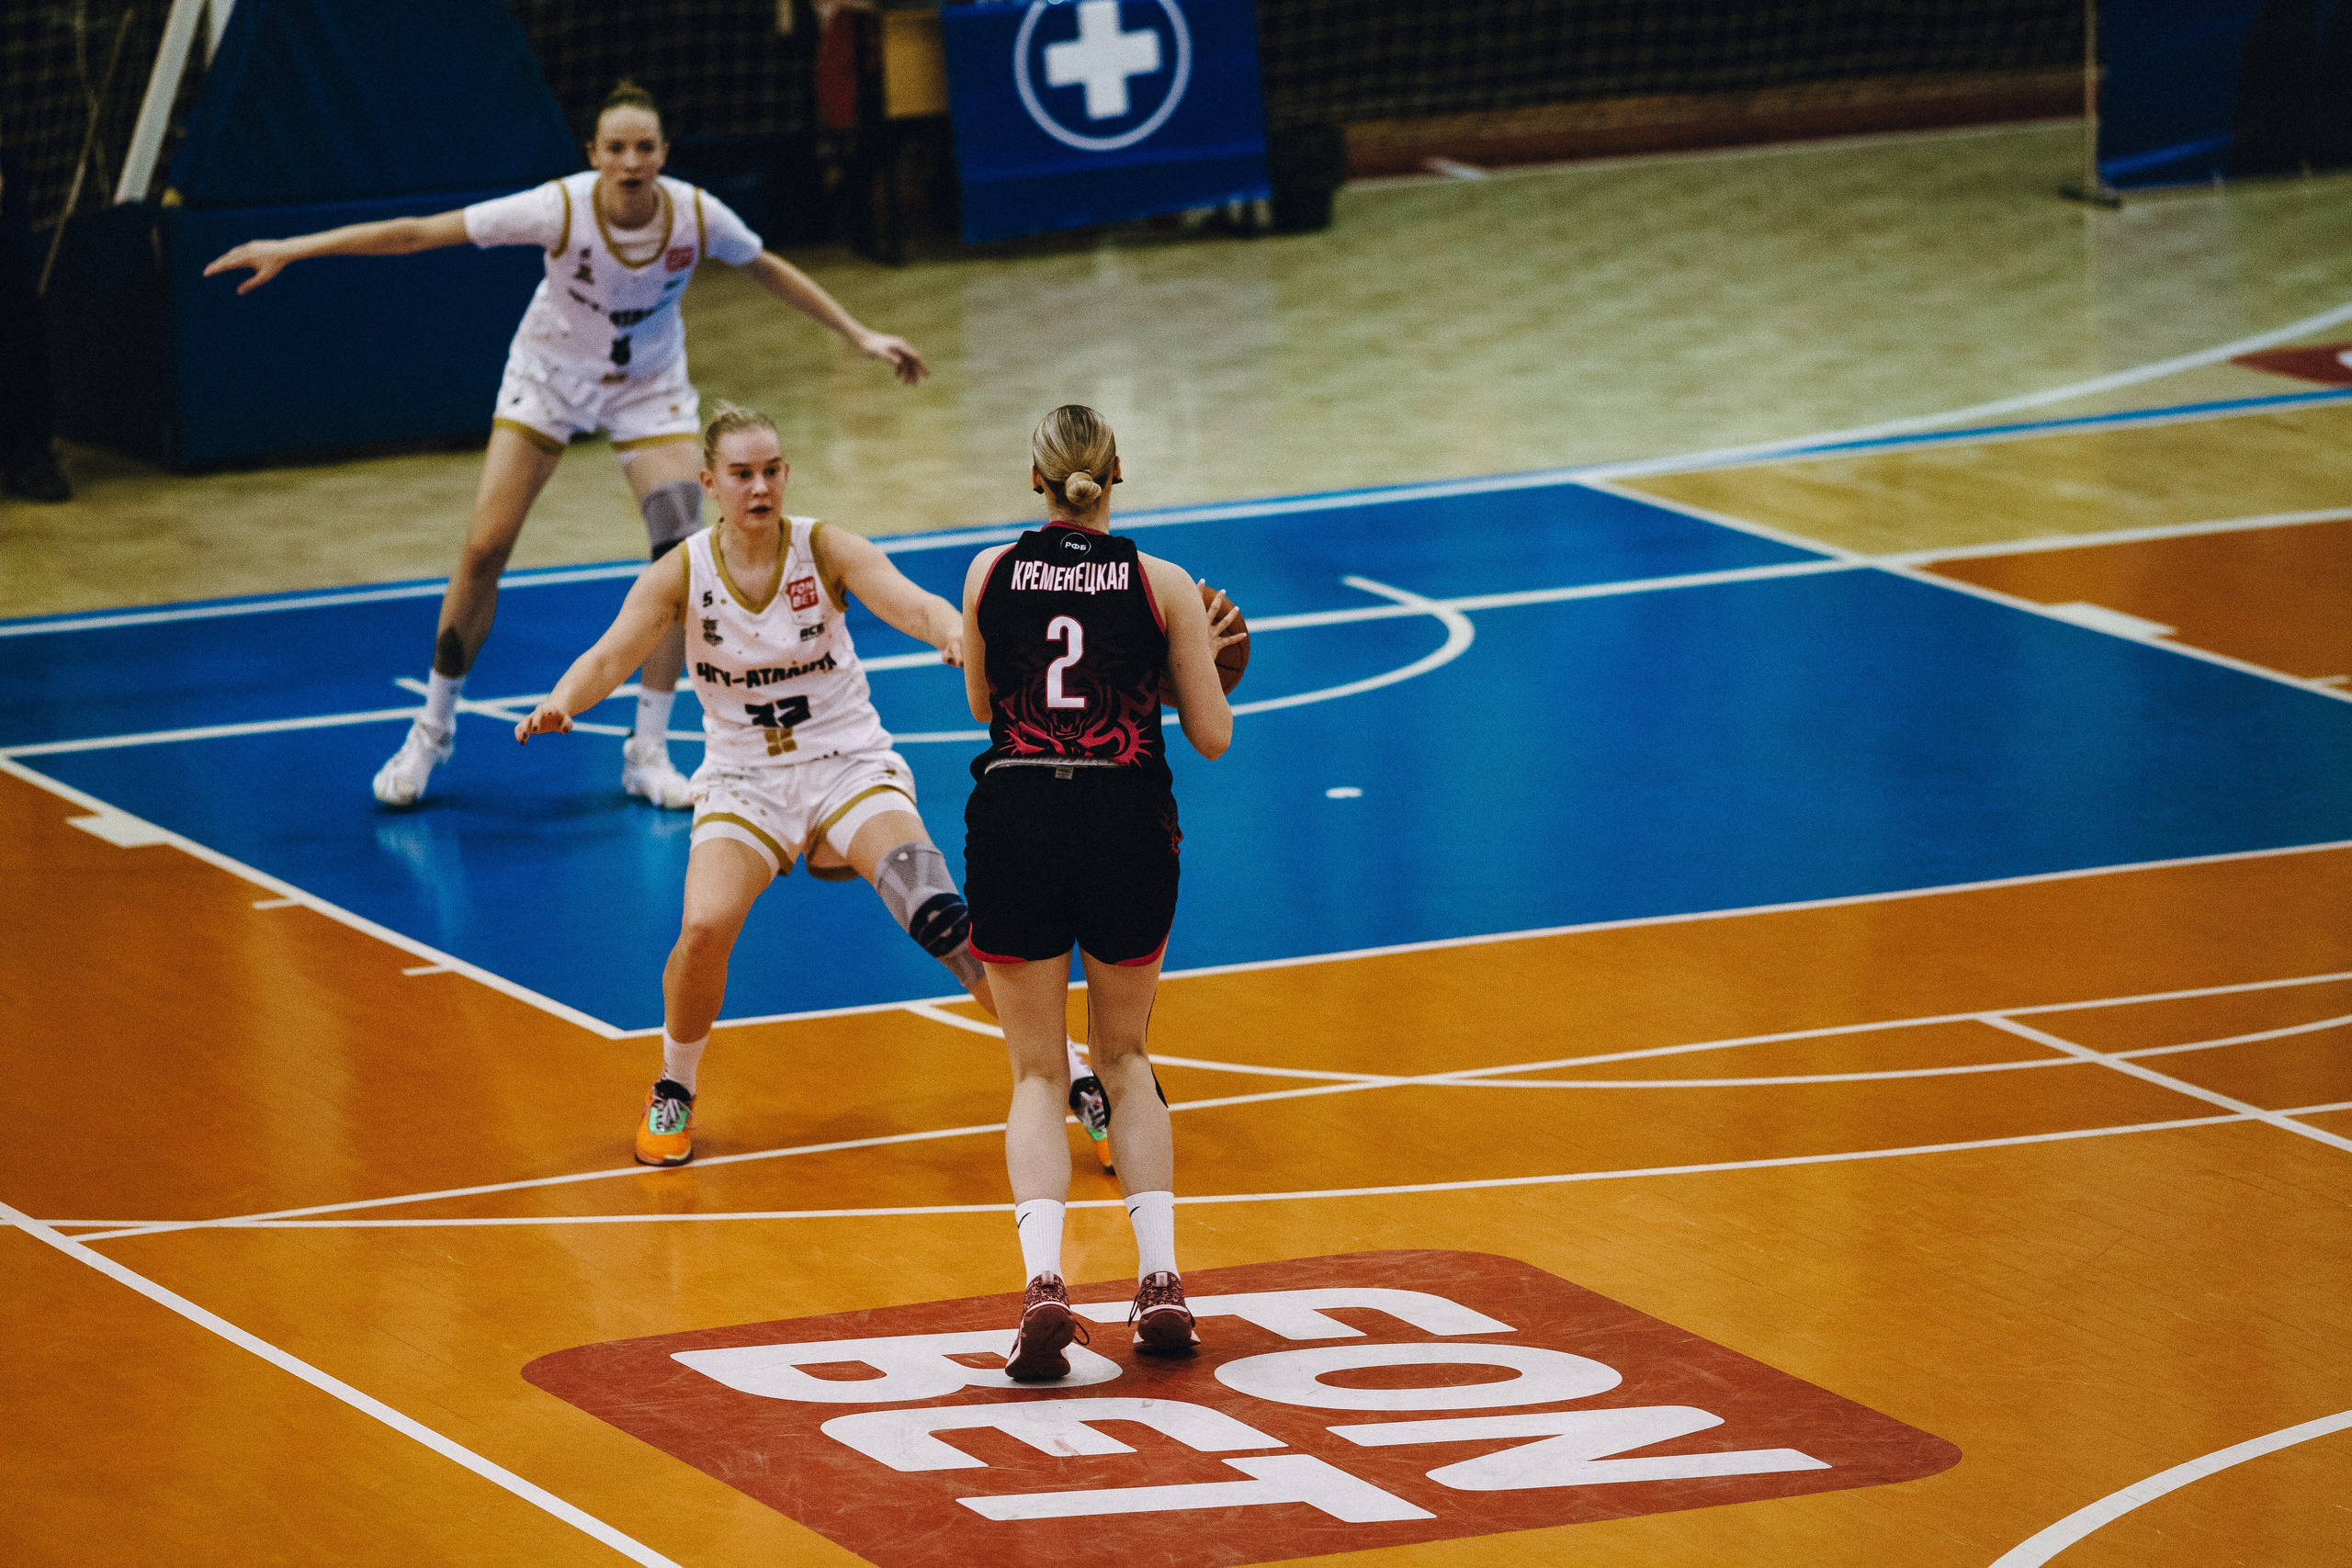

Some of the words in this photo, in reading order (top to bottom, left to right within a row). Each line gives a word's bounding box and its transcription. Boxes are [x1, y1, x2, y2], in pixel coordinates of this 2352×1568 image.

[1011, 559, 1130, 596] КРЕМЕНЕЦКАЯ
[1065, 540, 1087, 551] РФБ
[1046, 615, 1088, 711] 2
[669, 1327, 1439, 1525] BET
[1069, 1287, 1834, 1492] FON
